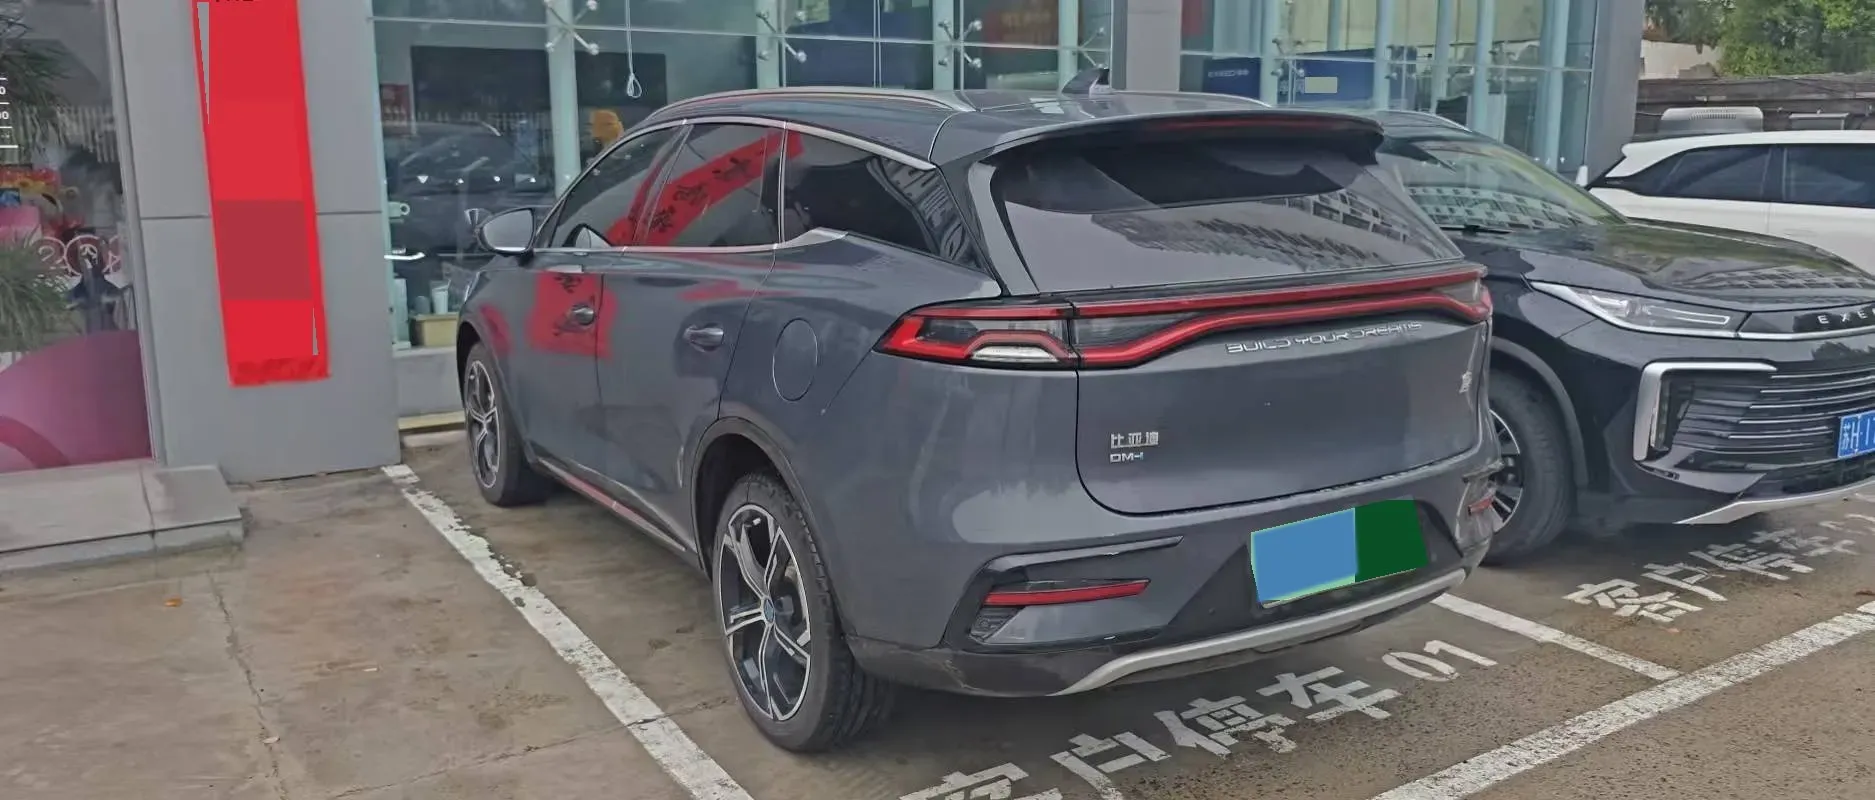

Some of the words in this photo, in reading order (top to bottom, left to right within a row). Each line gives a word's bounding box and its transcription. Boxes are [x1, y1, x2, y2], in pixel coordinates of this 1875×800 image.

[1817, 308, 1875, 325] EXE
[1227, 338, 1291, 353] BUILD
[1296, 333, 1349, 346] YOUR
[1350, 321, 1423, 339] DREAMS
[1110, 431, 1159, 449] 比亚迪
[1561, 528, 1860, 622] 客户停车
[1383, 639, 1498, 682] 01
